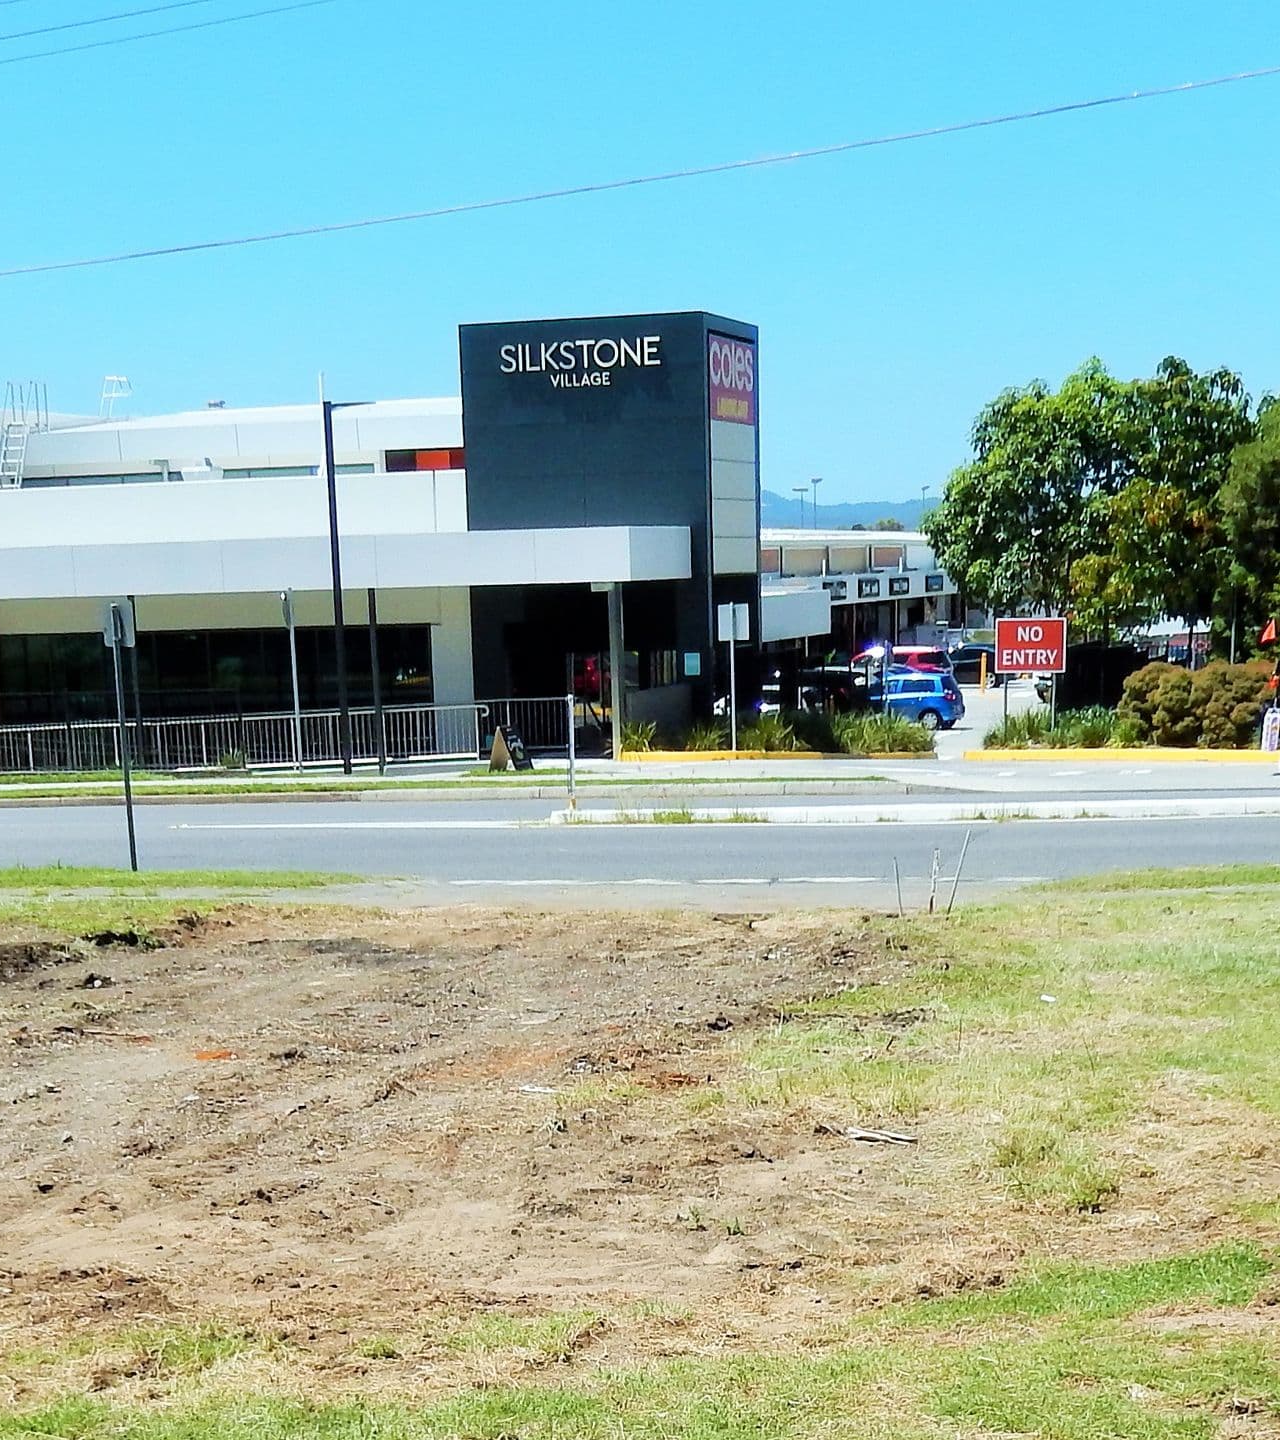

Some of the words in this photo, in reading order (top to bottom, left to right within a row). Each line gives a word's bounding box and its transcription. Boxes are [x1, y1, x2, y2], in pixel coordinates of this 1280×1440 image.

[500, 336, 661, 373] SILKSTONE
[710, 341, 753, 392] coles
[550, 372, 610, 388] VILLAGE
[1017, 626, 1043, 642] NO
[1002, 649, 1058, 666] ENTRY
